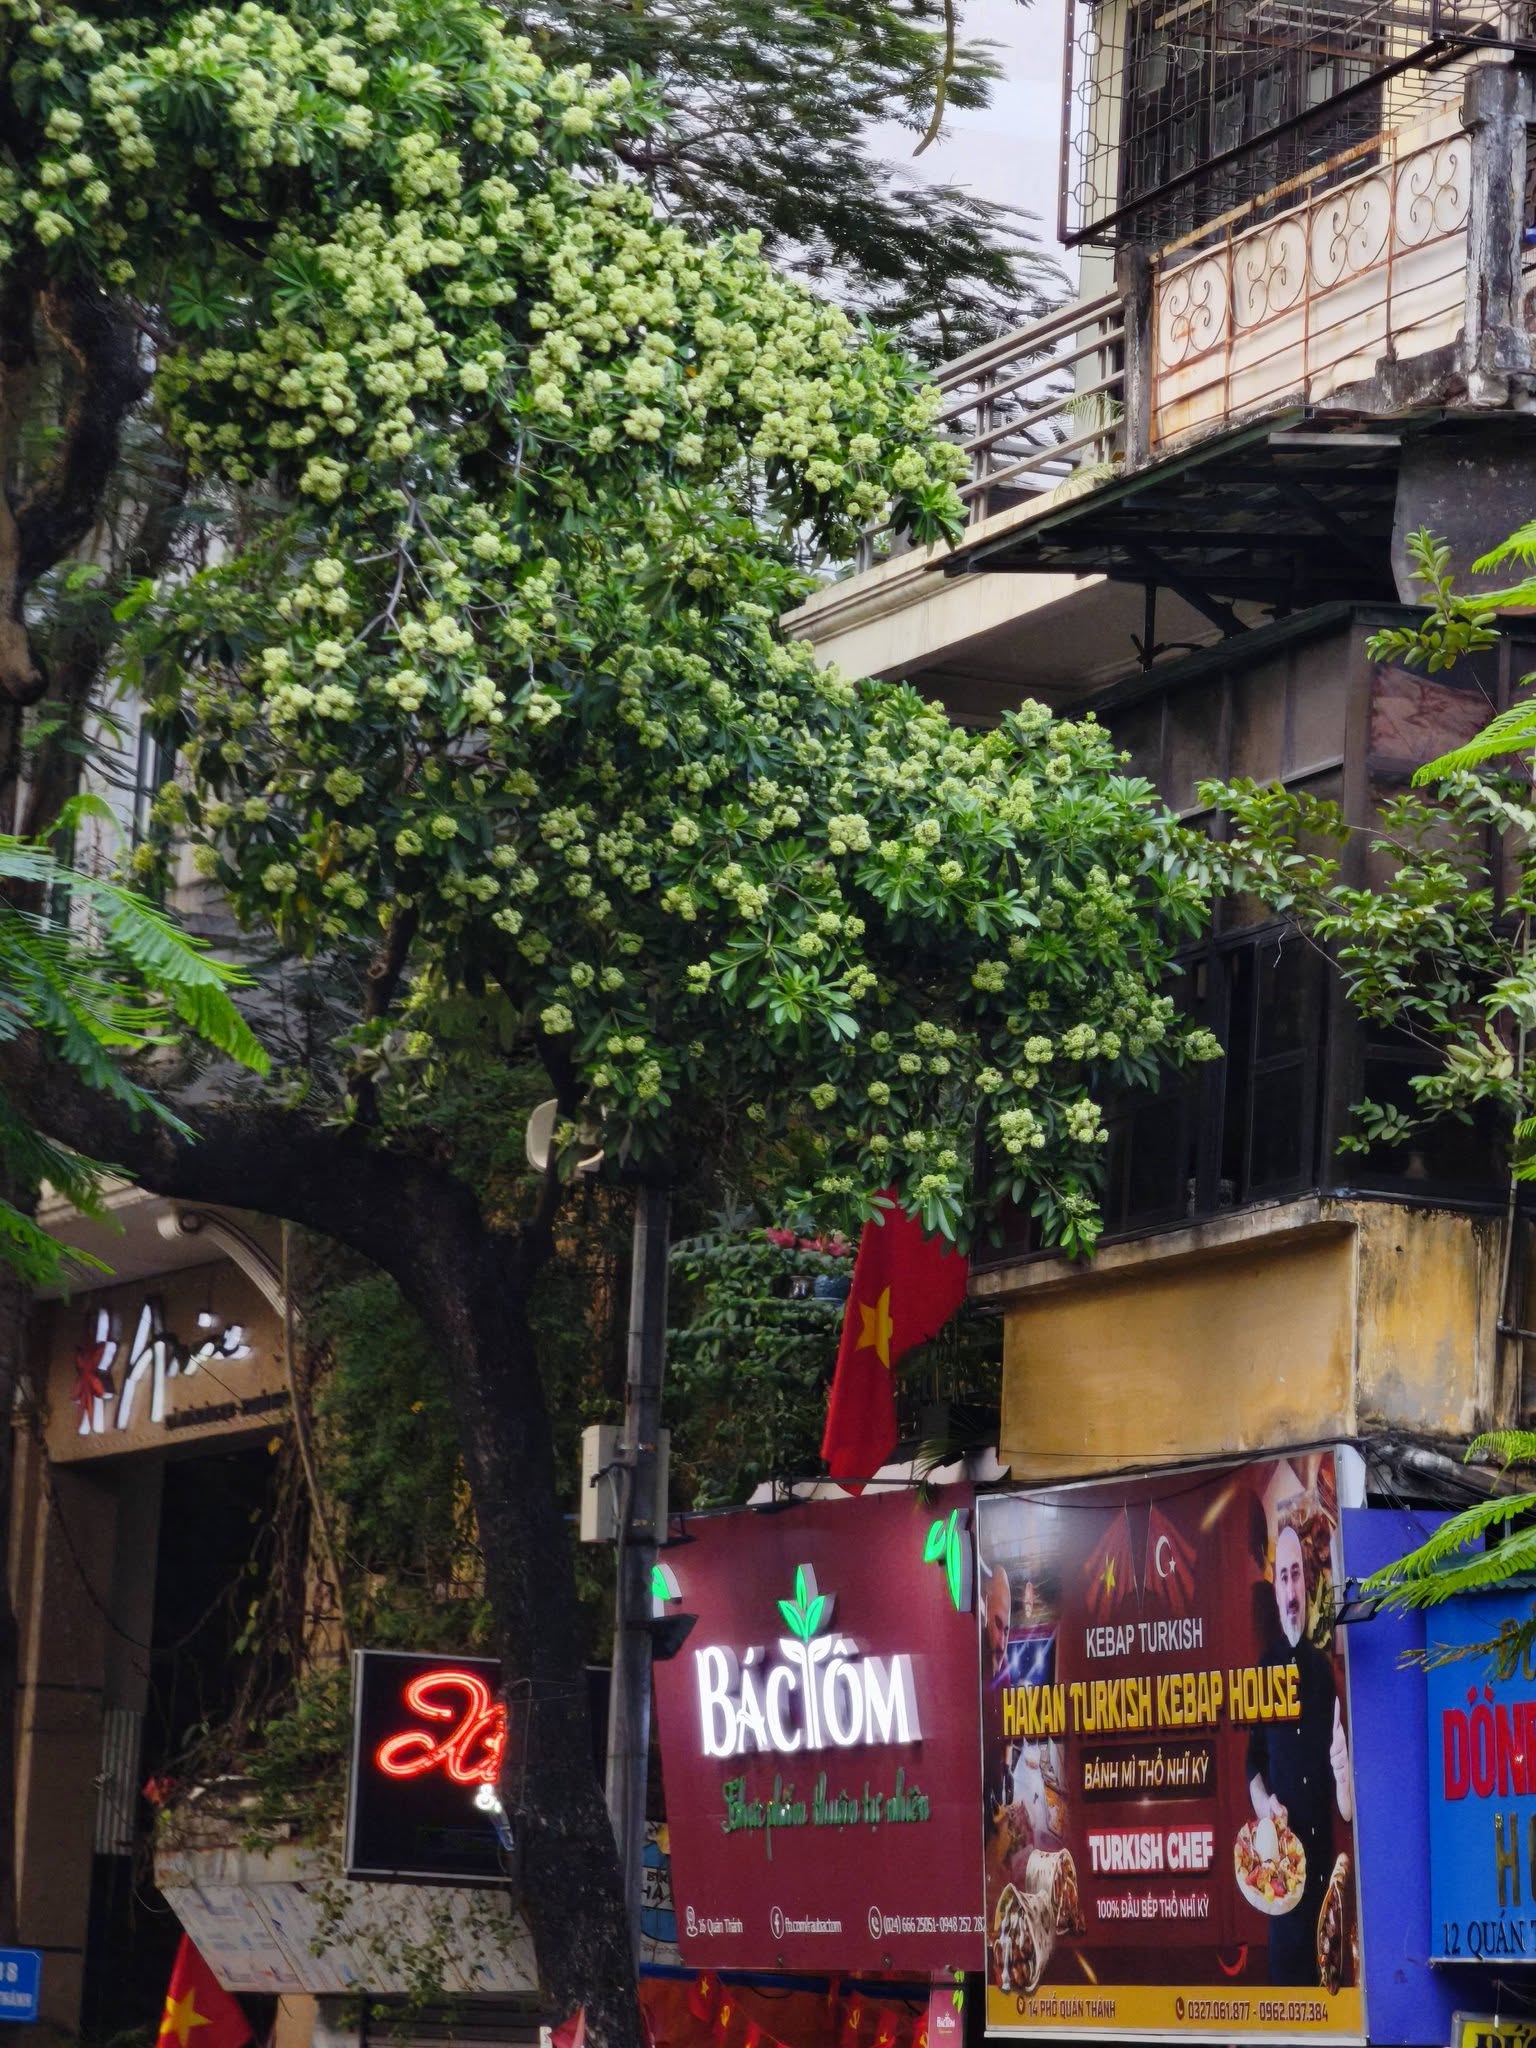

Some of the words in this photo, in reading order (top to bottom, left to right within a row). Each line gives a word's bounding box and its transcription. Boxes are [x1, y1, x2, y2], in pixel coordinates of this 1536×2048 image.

[1086, 1624, 1135, 1658] KEBAP
[1138, 1617, 1203, 1653] TURKISH
[1003, 1683, 1066, 1736] HAKAN
[1070, 1676, 1152, 1731] TURKISH
[1157, 1670, 1223, 1725] KEBAP
[1229, 1664, 1301, 1720] HOUSE
[1084, 1756, 1119, 1790] BÁNH
[1121, 1753, 1136, 1788] MÌ
[1138, 1747, 1164, 1787] THỔ
[1167, 1750, 1189, 1785] NHĨ
[1089, 1833, 1164, 1871] TURKISH
[1167, 1831, 1213, 1869] CHEF
[1097, 1900, 1120, 1919] 100%
[1121, 1892, 1140, 1919] ĐẦU
[1141, 1891, 1158, 1918] BẾP
[1160, 1890, 1178, 1918] THỔ
[1444, 1922, 1461, 1955] 12
[1467, 1909, 1527, 1961] QUÁN
[1028, 2000, 1038, 2017] 14
[1040, 1992, 1058, 2018] PHỐ
[1188, 2001, 1250, 2021] 0327.061.877
[1260, 2002, 1328, 2022] 0962.037.384
